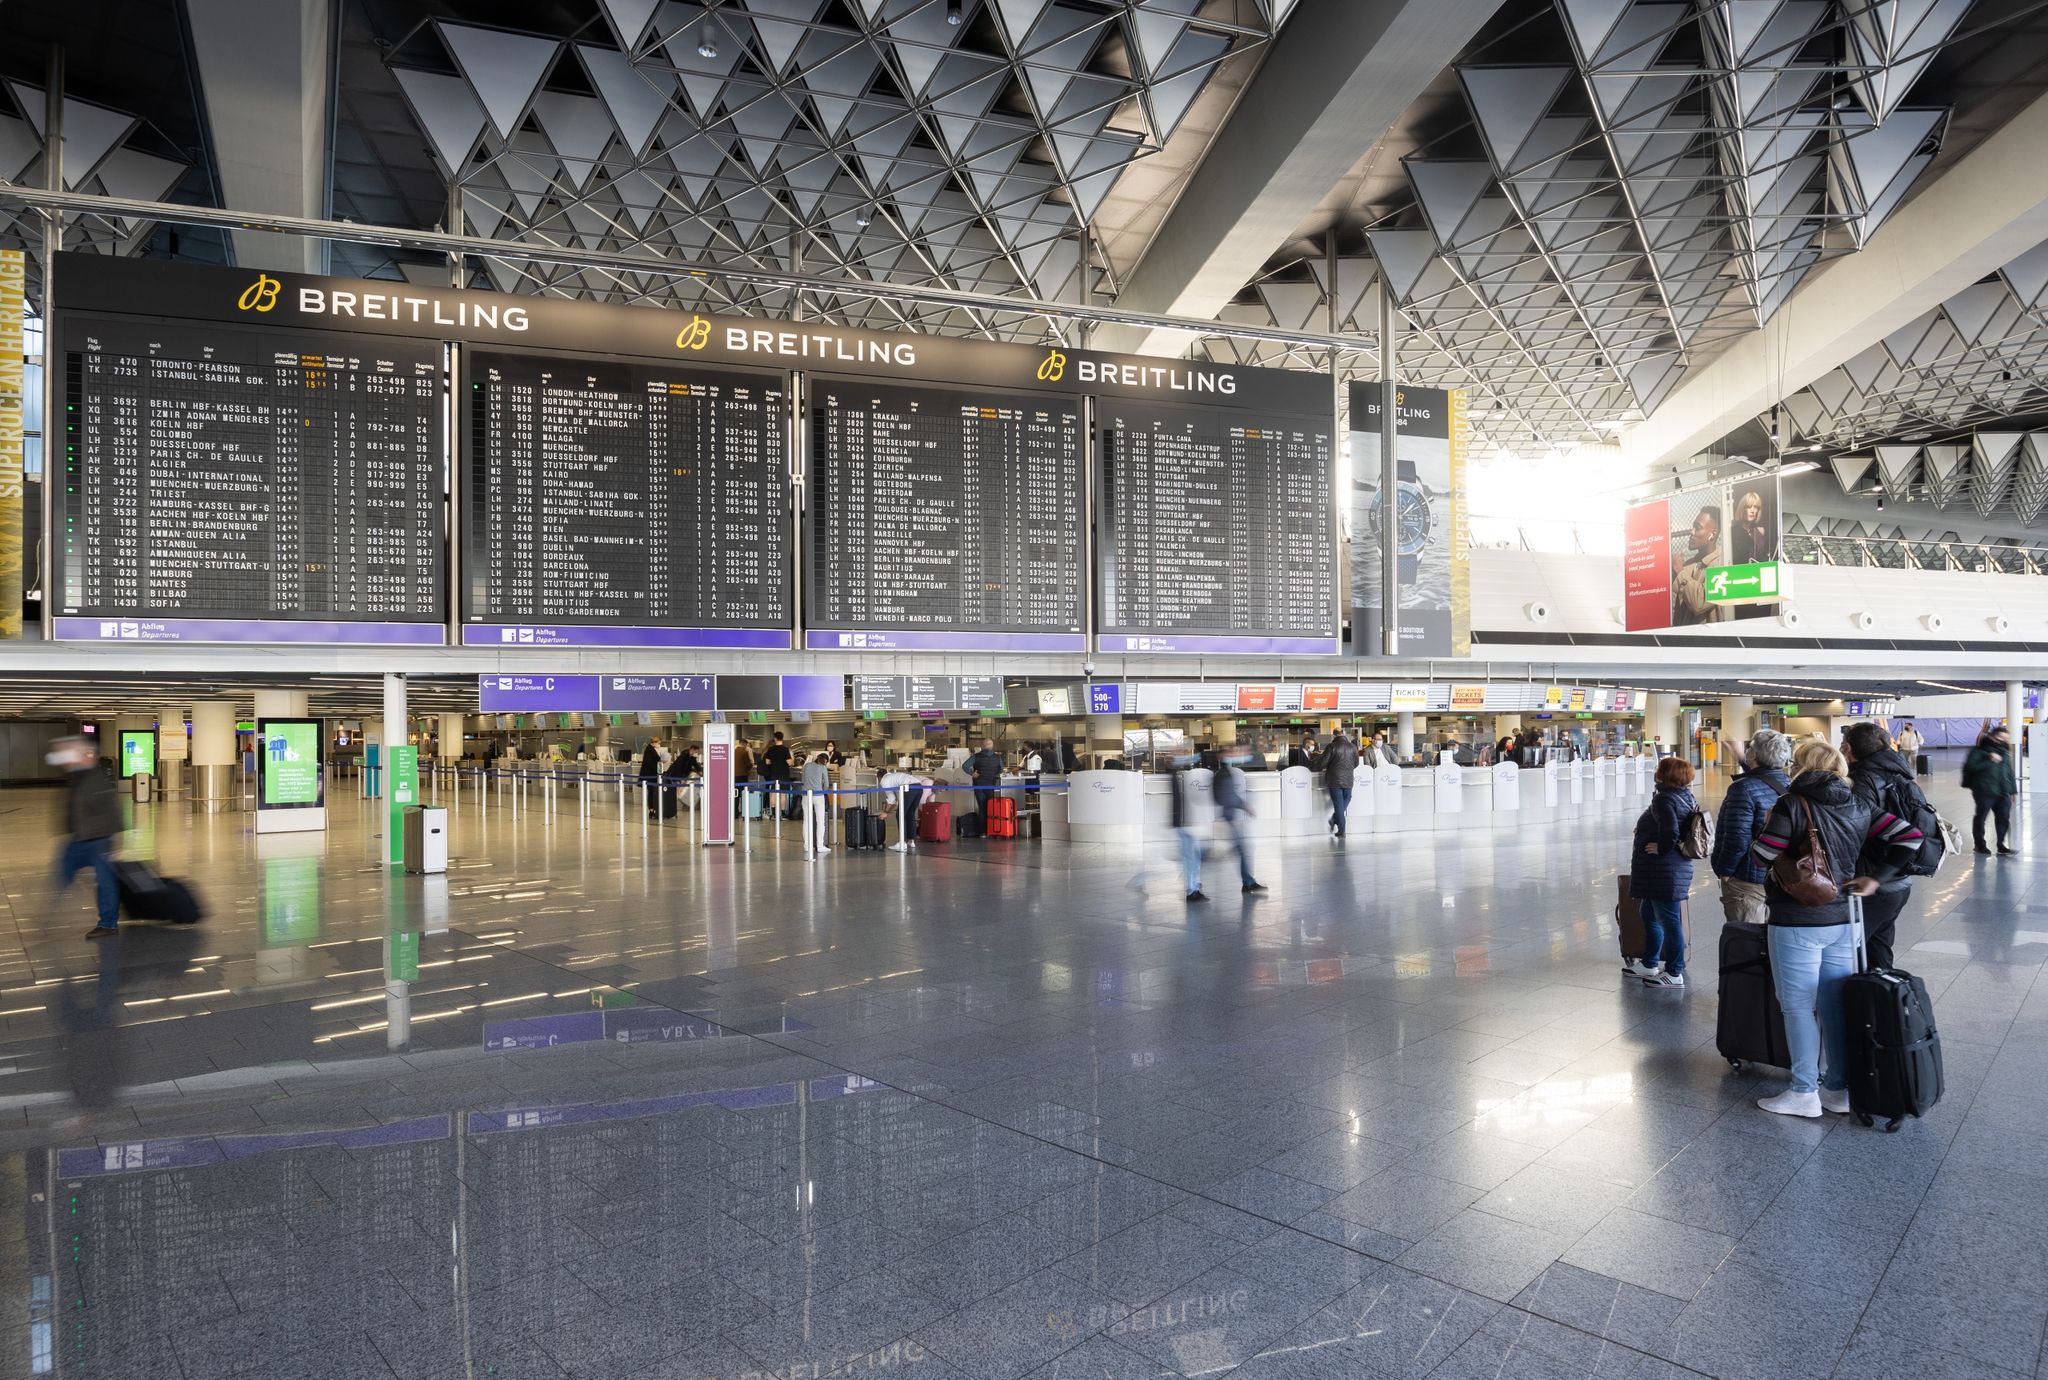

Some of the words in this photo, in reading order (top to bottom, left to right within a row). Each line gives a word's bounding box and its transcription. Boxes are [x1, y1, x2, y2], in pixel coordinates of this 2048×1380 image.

[0, 250, 24, 354] HERITAGE
[299, 288, 529, 331] BREITLING
[726, 328, 916, 366] BREITLING
[151, 360, 240, 373] TORONTO-PEARSON
[152, 371, 240, 383] ISTANBUL-SABIHA
[1078, 361, 1236, 394] BREITLING
[151, 400, 186, 409] BERLIN
[193, 403, 251, 413] HBF-KASSEL
[152, 410, 180, 418] IZMIR
[223, 415, 269, 424] MENDERES
[151, 420, 180, 428] KOELN
[1454, 391, 1469, 460] HERITAGE
[0, 361, 23, 498] SUPEROCEAN
[151, 430, 192, 439] COLOMBO
[151, 440, 215, 450] DUESSELDORF
[151, 450, 180, 458] PARIS
[229, 454, 263, 463] GAULLE
[151, 460, 186, 468] ALGIER
[151, 470, 263, 482] DUBAI-INTERNATIONAL
[151, 480, 269, 492] MUENCHEN-WUERZBURG-N
[151, 490, 186, 498] TRIEST
[151, 500, 233, 510] HAMBURG-KASSEL
[241, 504, 269, 512] BHF-G
[150, 510, 186, 518] AACHEN
[193, 512, 246, 520] HBF-KOELN
[150, 520, 257, 531] BERLIN-BRANDENBURG
[150, 530, 216, 539] AMMAN-QUEEN
[152, 540, 197, 548] ISTANBUL
[150, 550, 216, 559] AMMANHQUEEN
[150, 560, 269, 570] MUENCHEN-STUTTGART-U
[151, 570, 192, 578] HAMBURG
[150, 580, 186, 588] NANTES
[151, 590, 186, 598] BILBAO
[514, 684, 544, 692] Departures
[546, 678, 554, 691] C
[628, 684, 656, 692] Departures
[1094, 703, 1108, 711] 570
